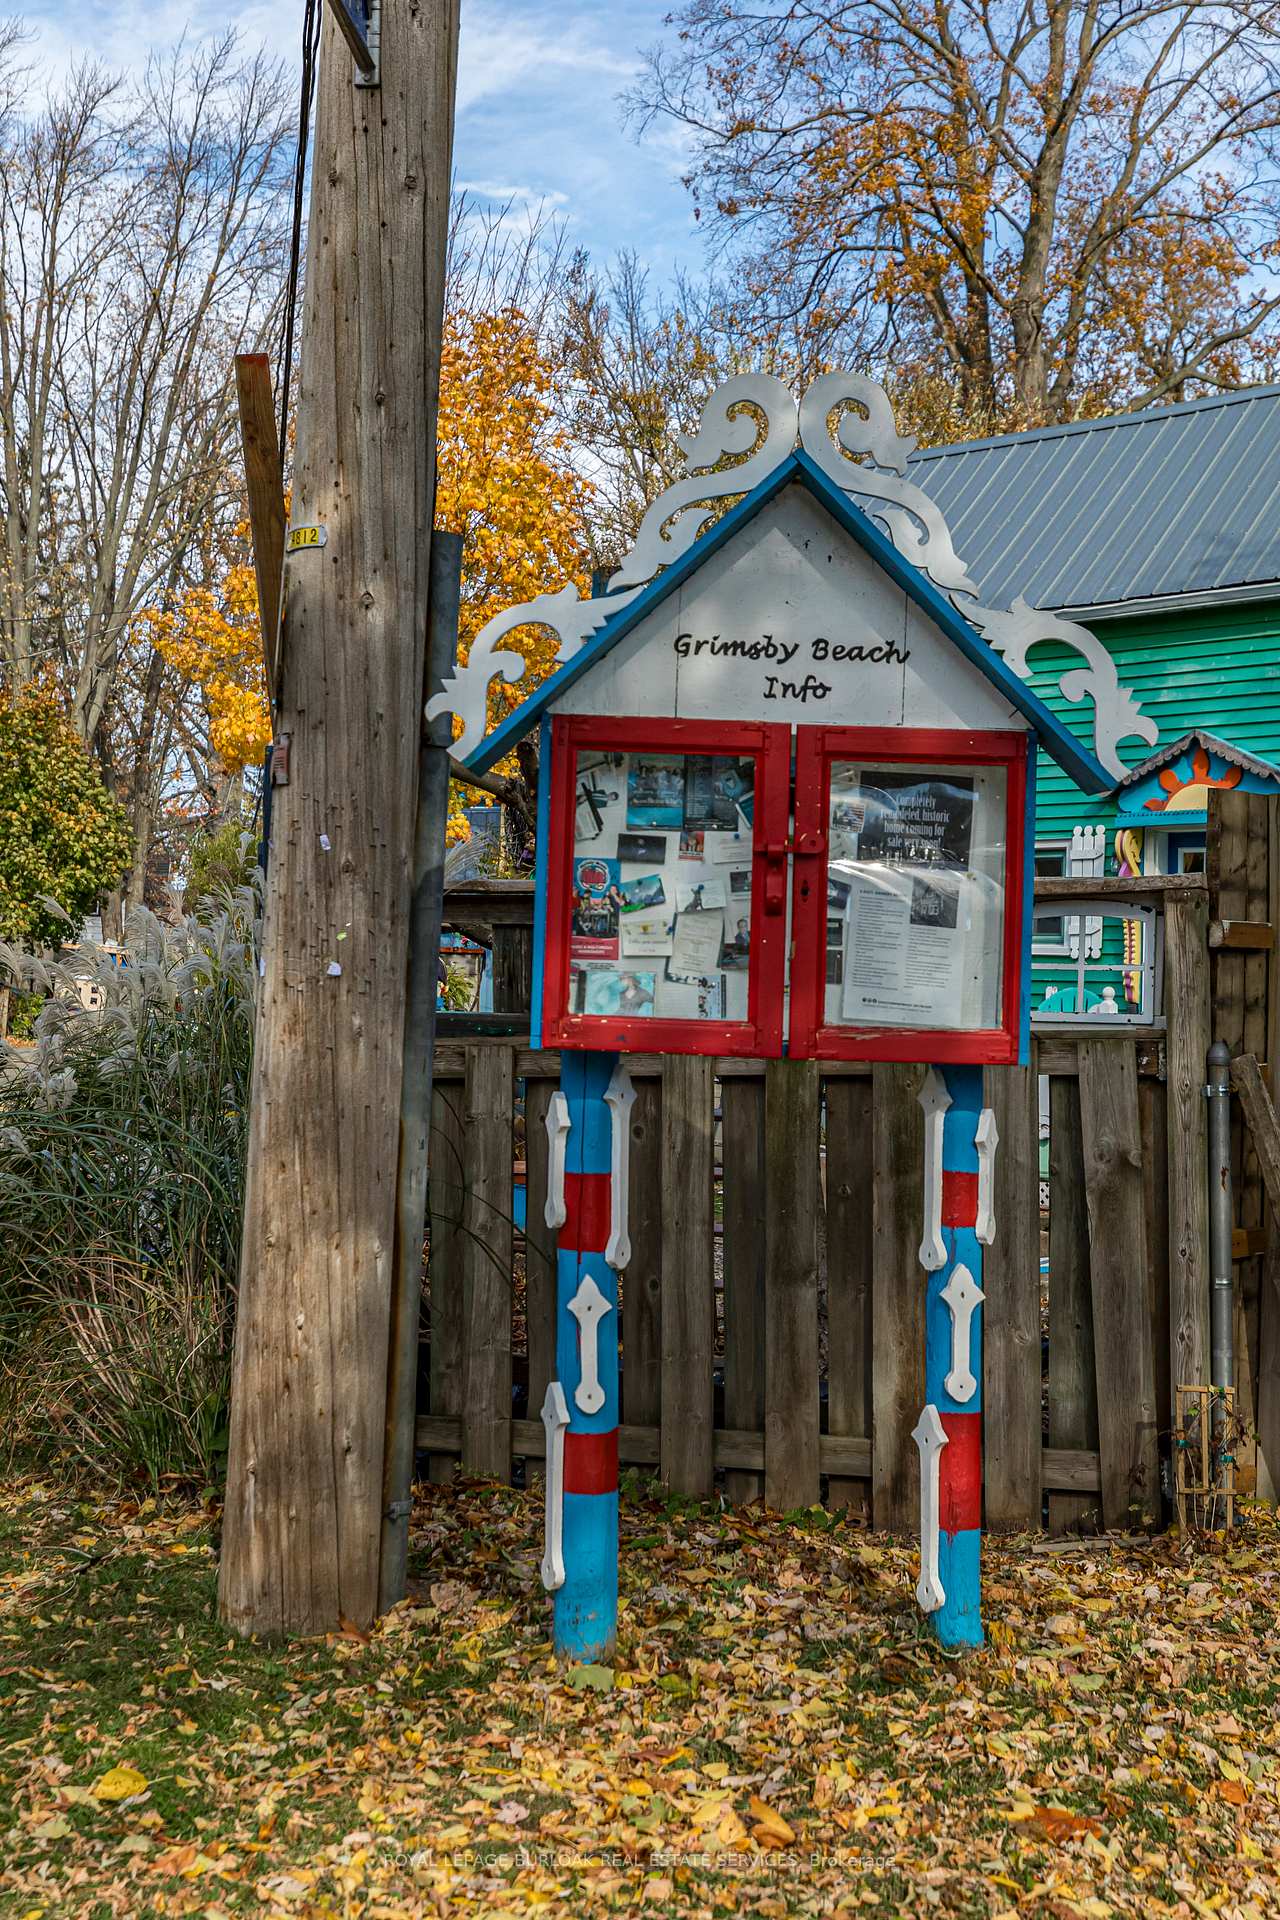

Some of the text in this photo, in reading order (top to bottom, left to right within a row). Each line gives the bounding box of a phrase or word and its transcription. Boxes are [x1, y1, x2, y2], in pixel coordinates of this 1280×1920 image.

[673, 633, 911, 665] Grimsby Beach
[762, 674, 832, 703] Info
[896, 793, 937, 809] Completely
[922, 808, 950, 823] historic
[884, 820, 945, 837] home coming for
[887, 835, 903, 848] sale
